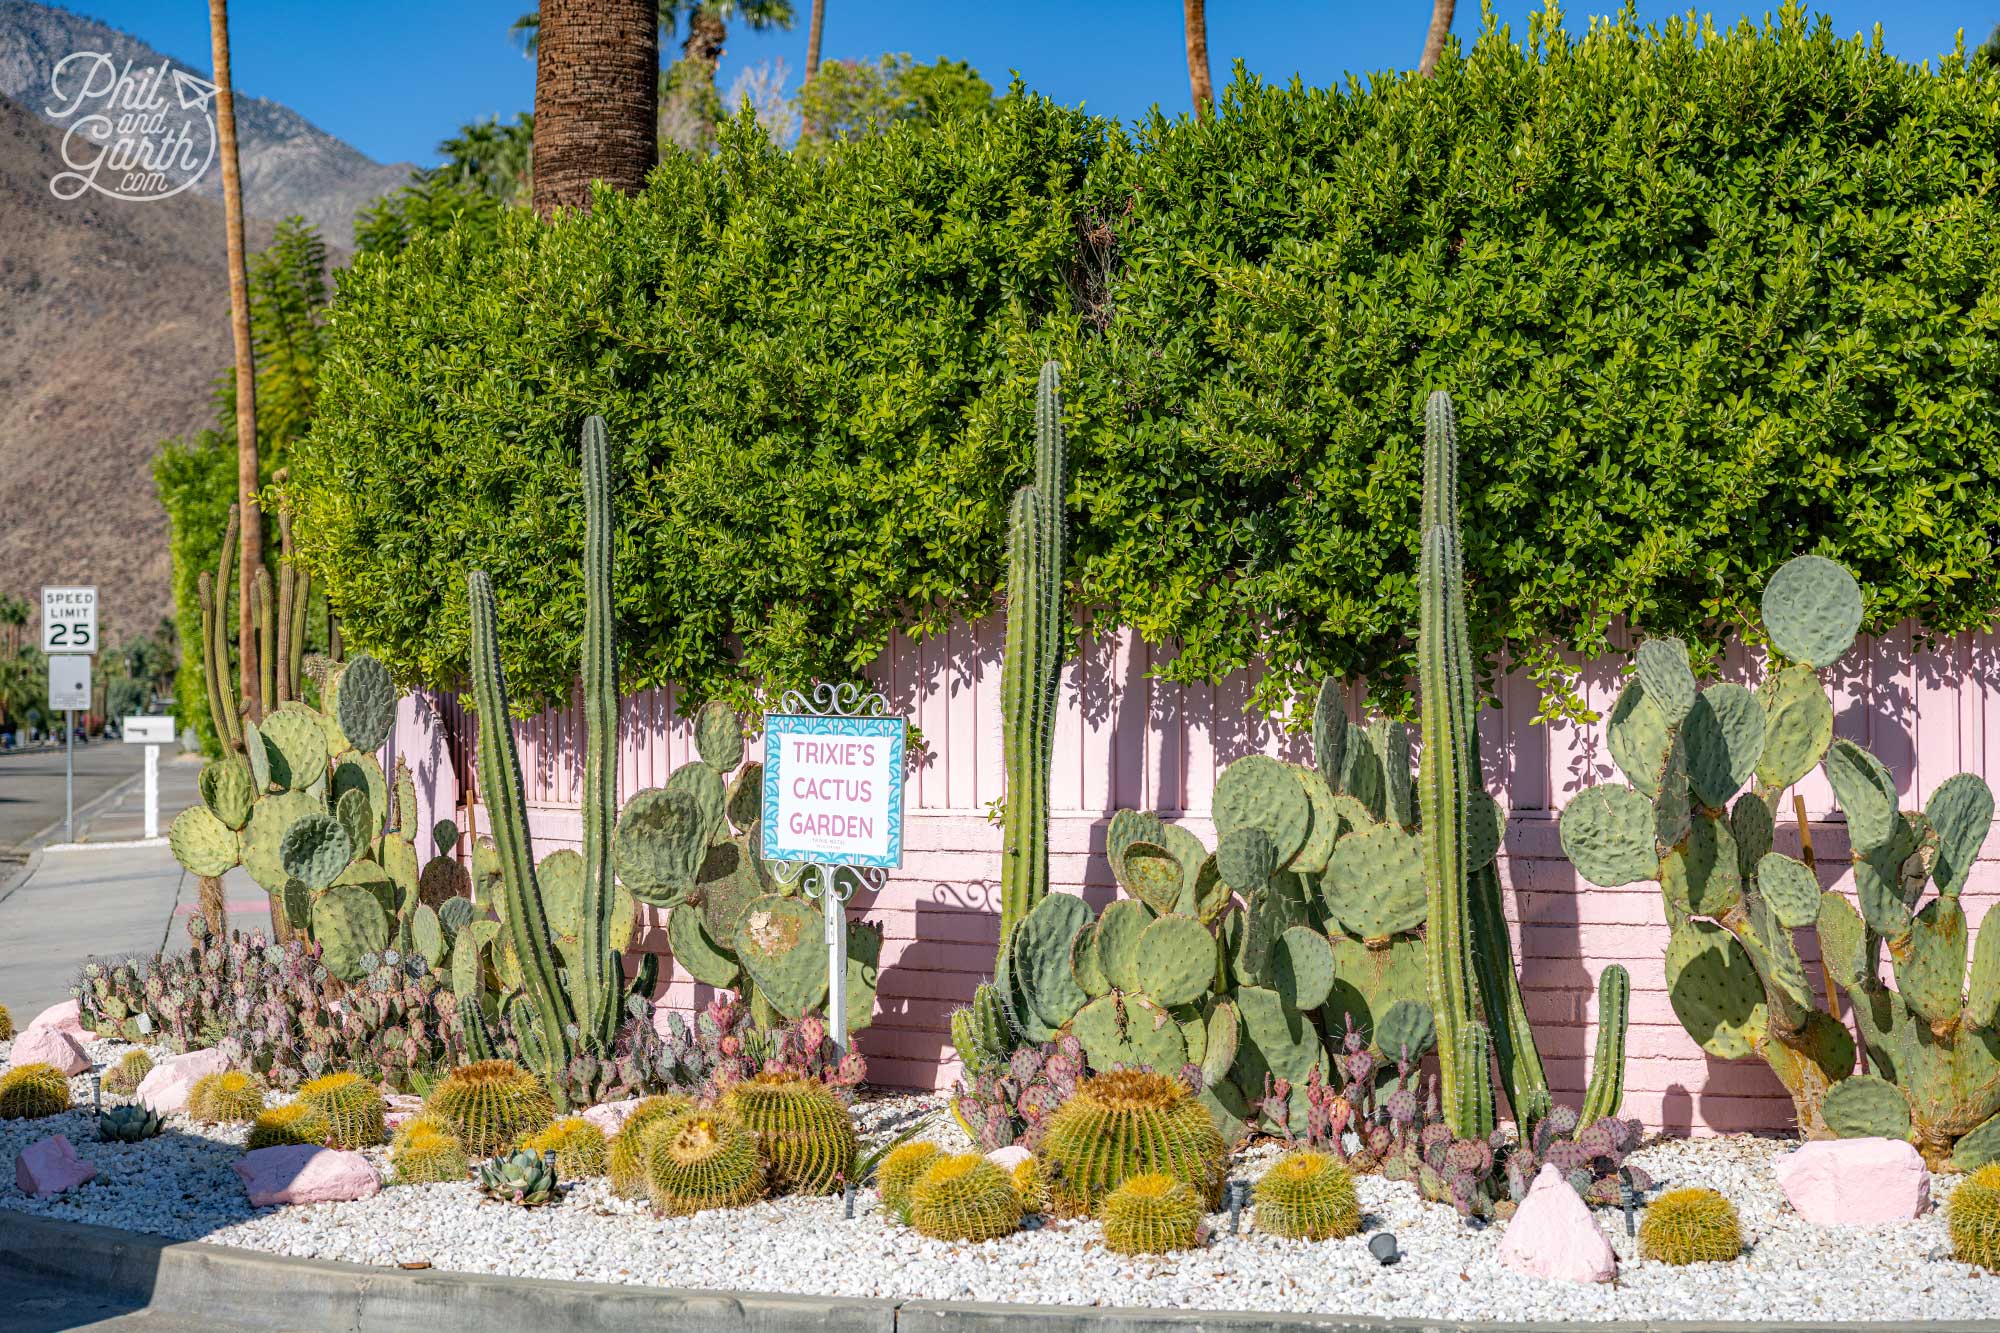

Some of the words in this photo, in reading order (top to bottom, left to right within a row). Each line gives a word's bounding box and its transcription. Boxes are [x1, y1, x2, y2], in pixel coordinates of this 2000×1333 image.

[47, 593, 93, 604] SPEED
[51, 608, 89, 618] LIMIT
[49, 623, 90, 645] 25
[793, 777, 873, 803] CACTUS
[789, 812, 874, 840] GARDEN
